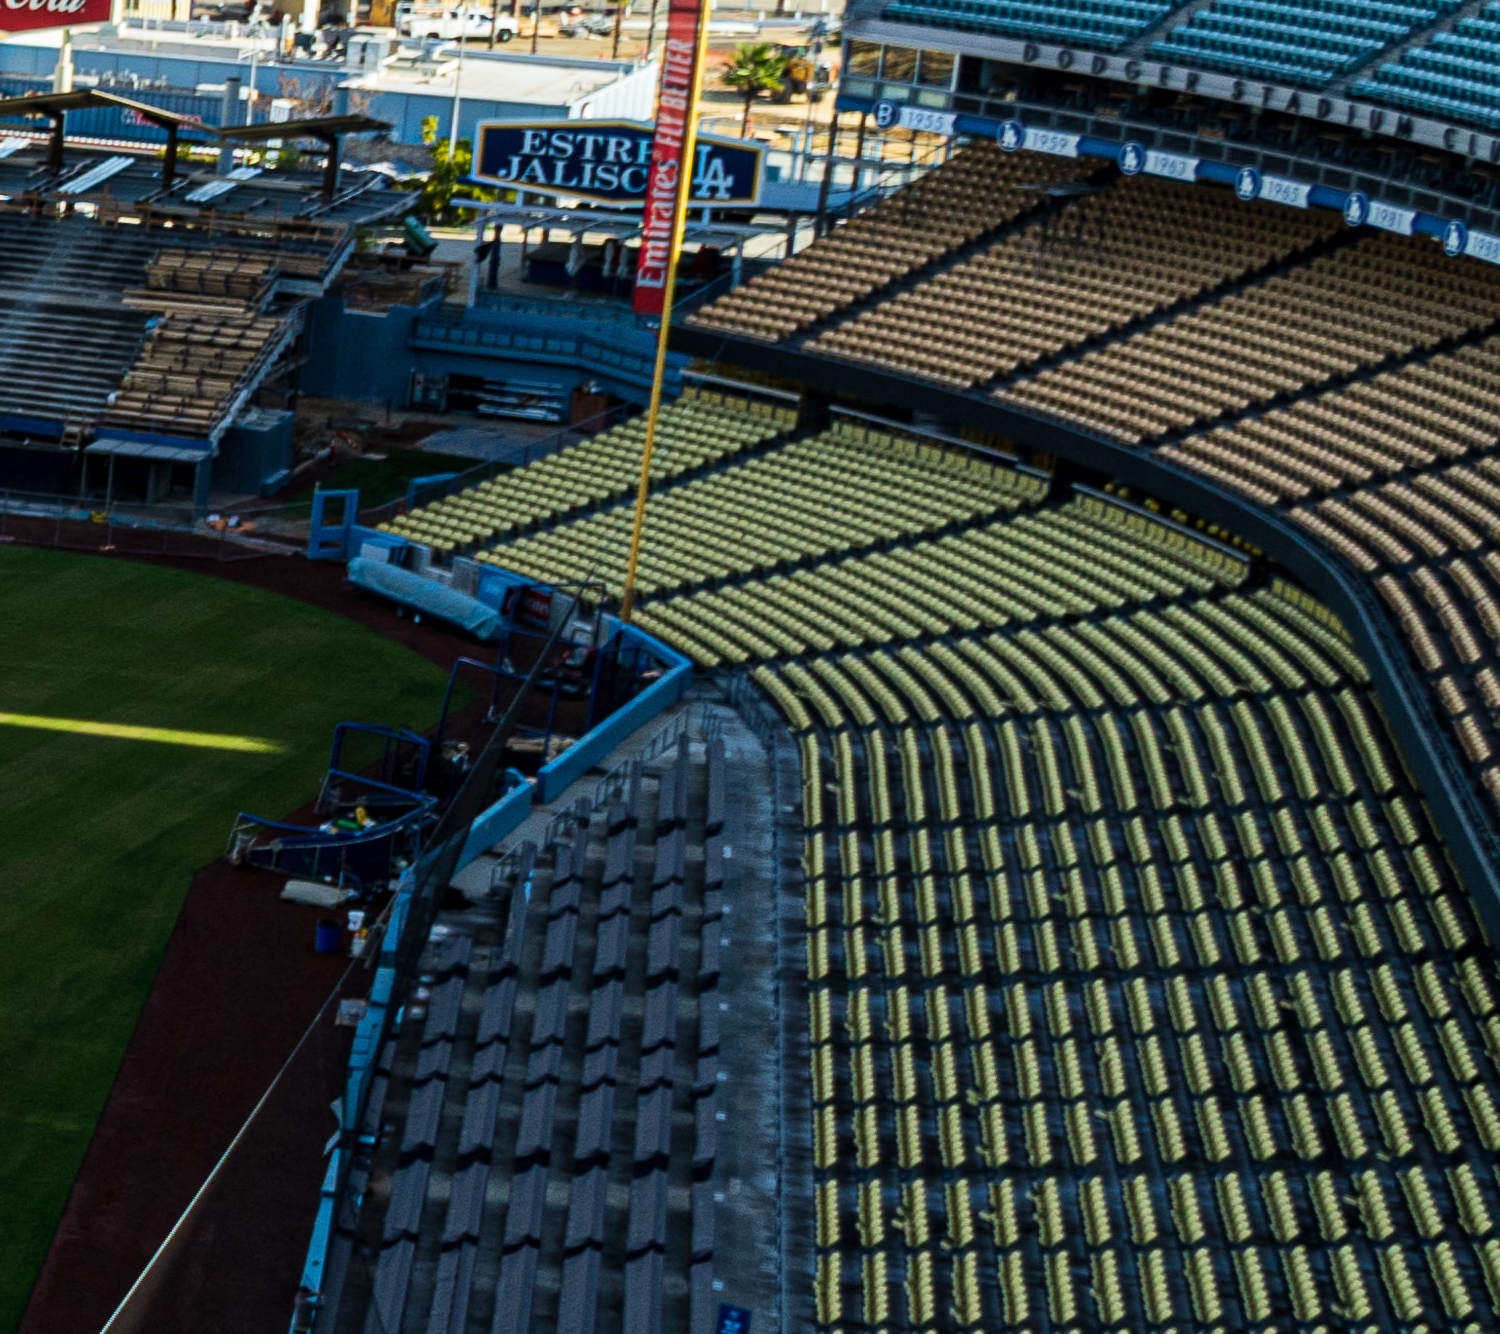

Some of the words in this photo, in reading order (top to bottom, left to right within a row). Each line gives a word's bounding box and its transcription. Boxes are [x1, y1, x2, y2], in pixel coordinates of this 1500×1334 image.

[660, 37, 694, 110] BETTER
[1023, 42, 1200, 93] DODGER
[1231, 79, 1414, 139] STADIUM
[655, 112, 684, 148] FLY
[498, 154, 648, 193] JALISC
[637, 157, 679, 289] Emirates
